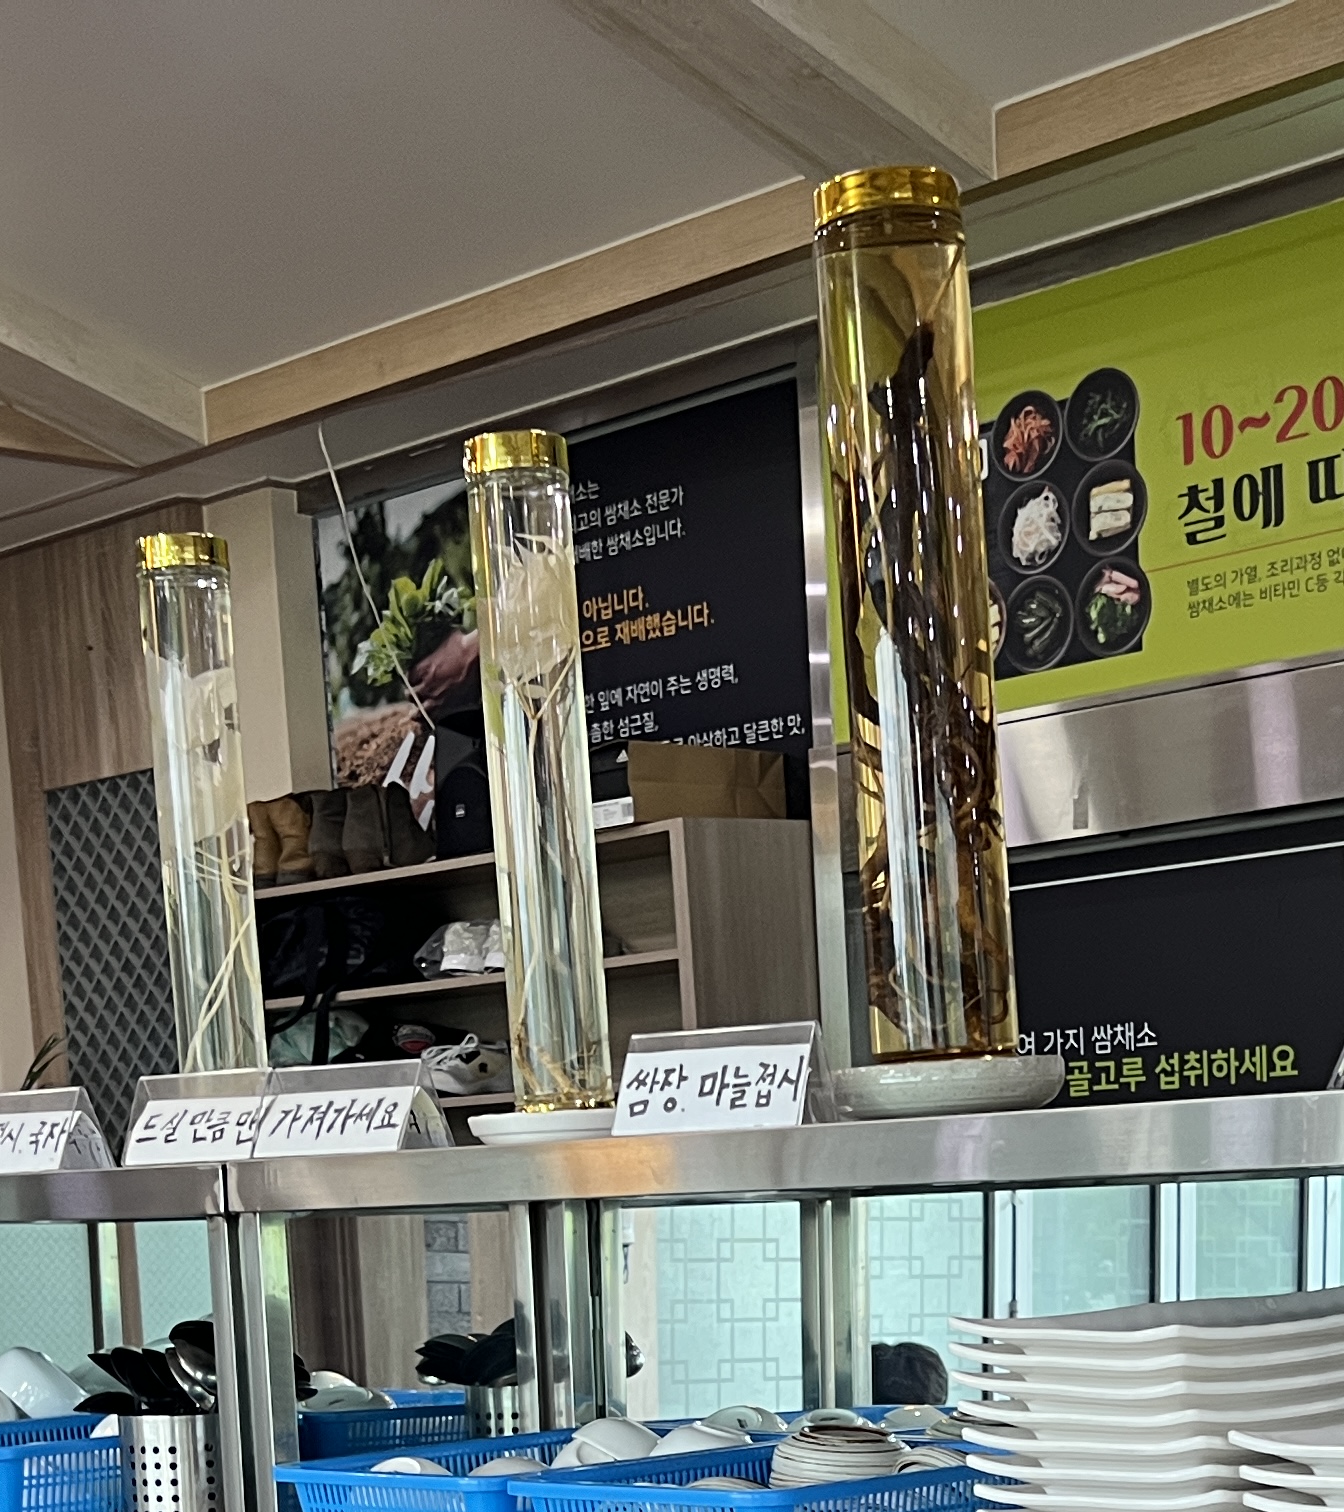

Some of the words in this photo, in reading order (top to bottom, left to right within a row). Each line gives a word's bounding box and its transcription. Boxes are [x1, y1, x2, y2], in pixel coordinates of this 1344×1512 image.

[572, 506, 602, 534] 고의
[604, 498, 643, 526] 쌈채소
[644, 484, 685, 515] 전문가
[1177, 462, 1285, 546] 철에
[1265, 551, 1323, 579] 조리과정
[582, 585, 650, 622] 아닙니다.
[1258, 576, 1301, 602] 비타민
[614, 601, 716, 646] 재배했습니다.
[625, 678, 664, 704] 자연이
[665, 674, 693, 697] 주는
[1042, 1026, 1085, 1056] 가지
[1090, 1021, 1159, 1054] 쌈채소
[697, 1054, 806, 1111] 마늘접시
[1066, 1054, 1147, 1098] 골고루
[1153, 1044, 1300, 1091] 섭취하세요
[29, 1116, 70, 1156] 국자
[268, 1096, 400, 1142] 가져가세요
